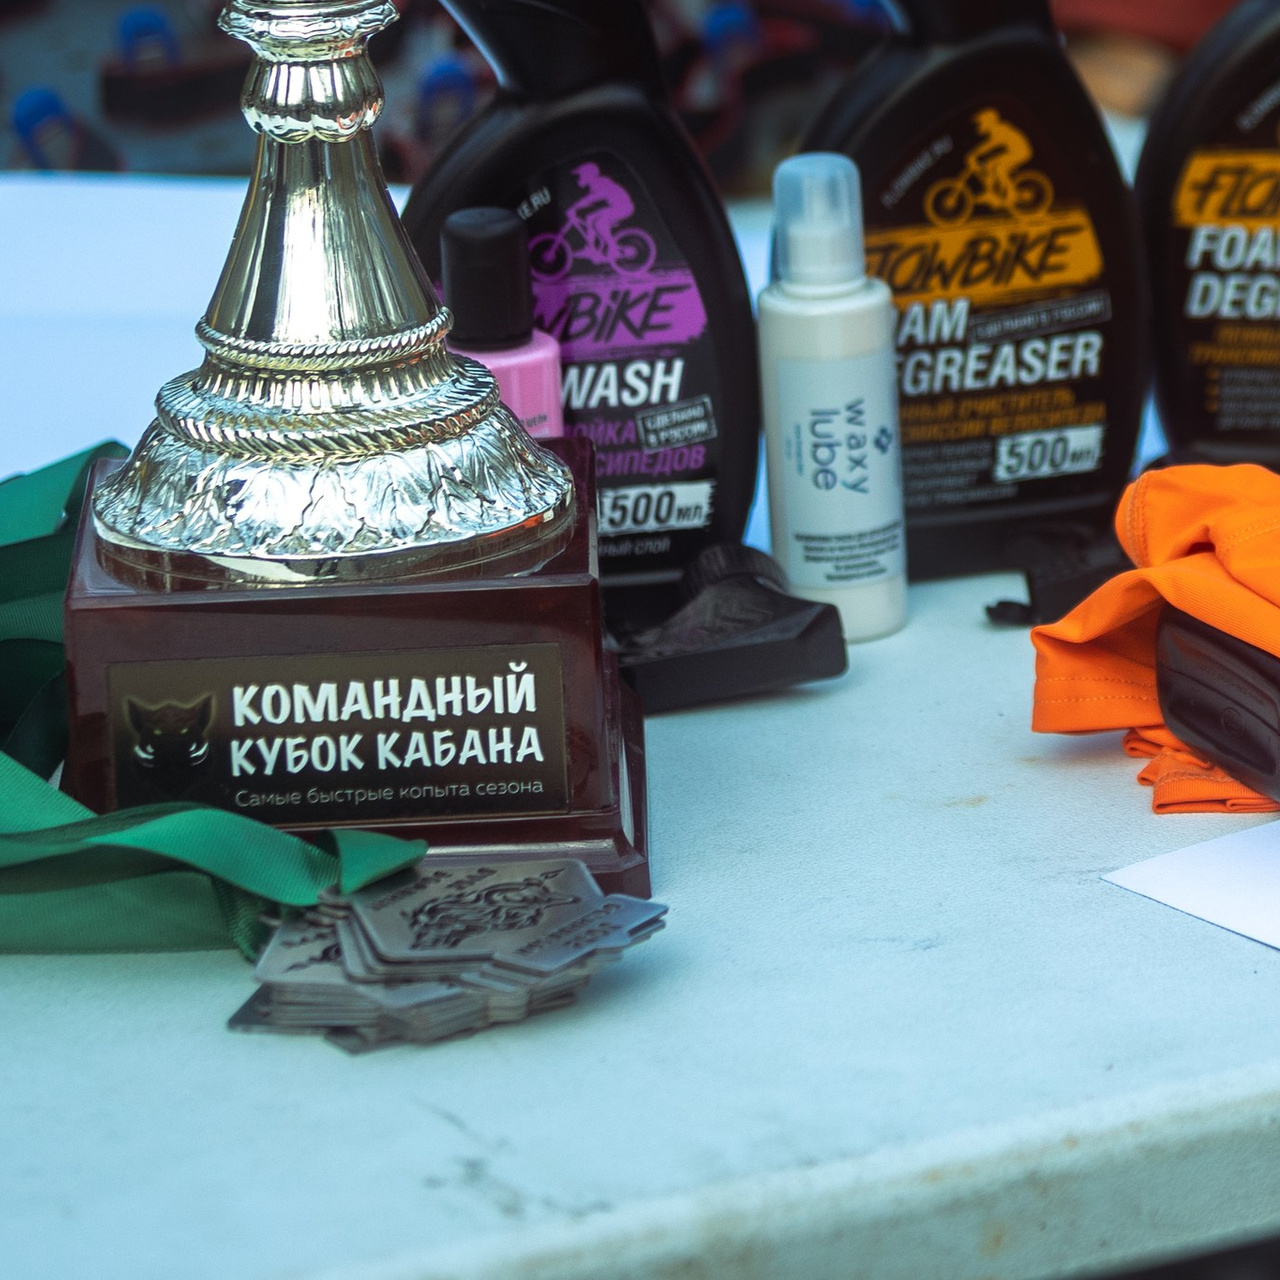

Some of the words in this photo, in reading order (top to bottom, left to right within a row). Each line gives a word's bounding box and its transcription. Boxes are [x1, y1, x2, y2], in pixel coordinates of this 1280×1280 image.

[810, 409, 842, 491] lube
[842, 397, 870, 493] waxy
[1004, 436, 1069, 474] 500
[608, 490, 676, 527] 500
[232, 660, 537, 727] КОМАНДНЫЙ
[230, 733, 365, 777] КУБОК
[376, 726, 544, 770] КАБАНА
[234, 789, 301, 808] Самые
[306, 782, 394, 805] быстрые
[400, 783, 470, 800] копыта
[475, 779, 544, 796] сезона
